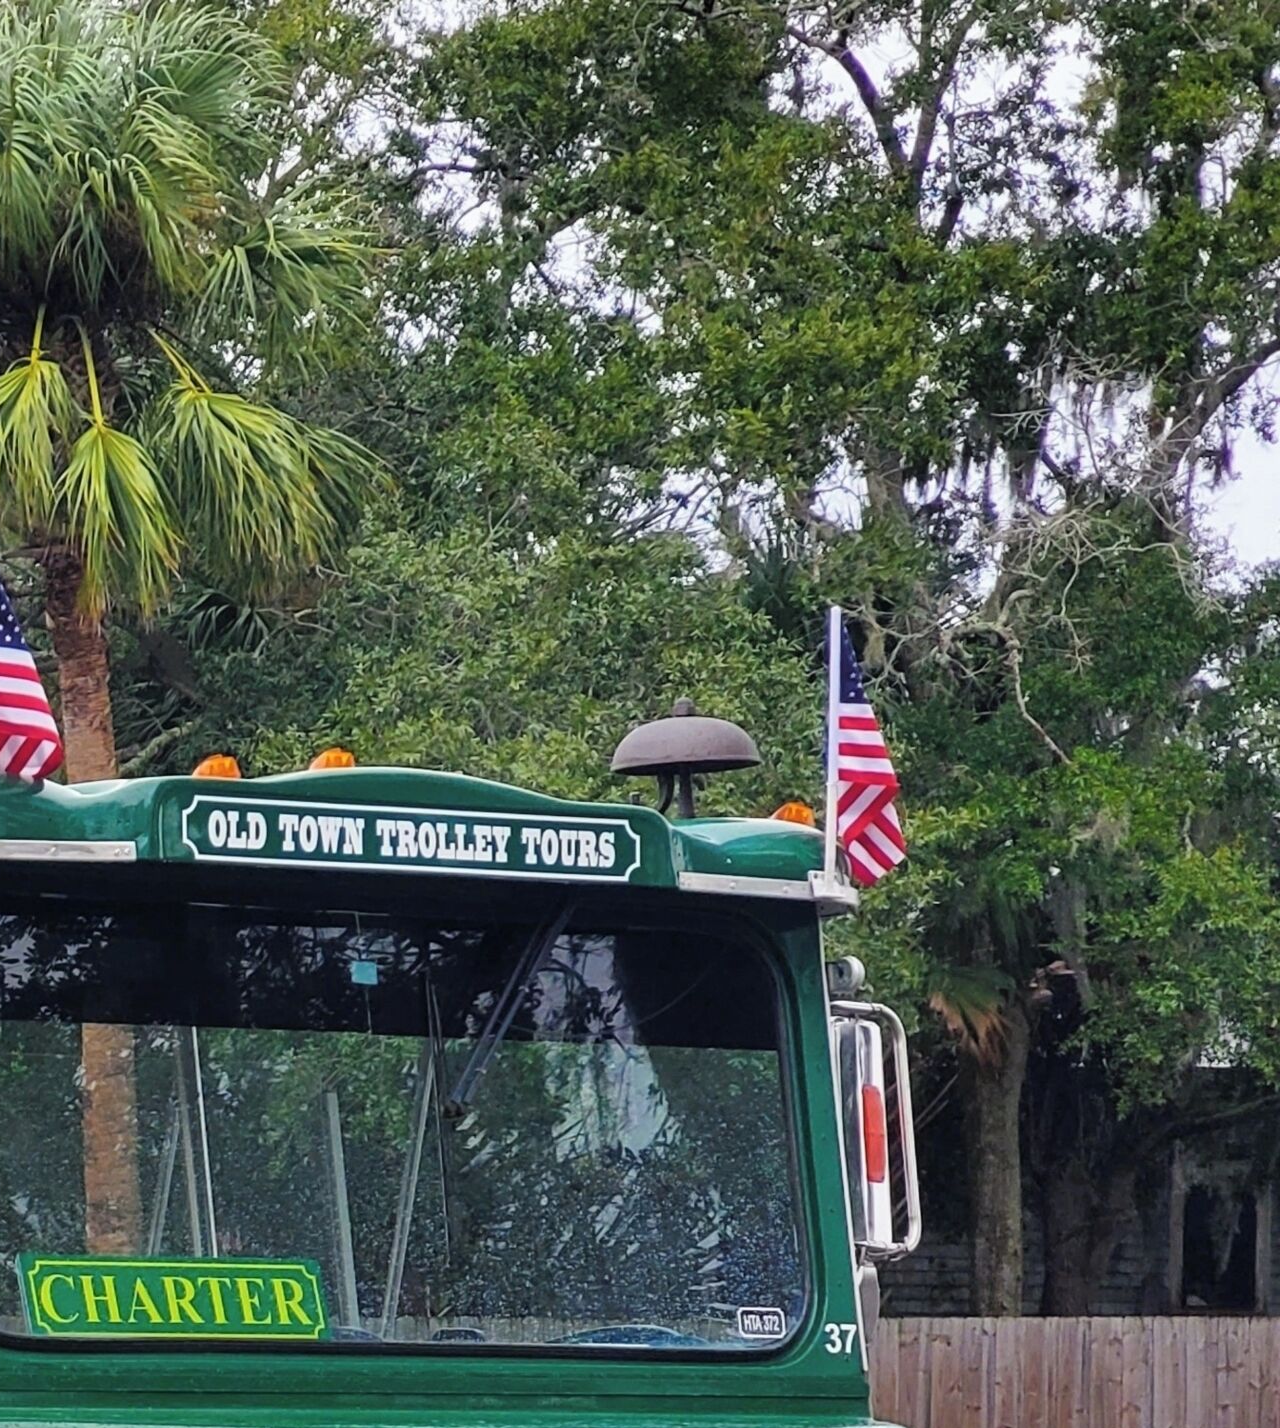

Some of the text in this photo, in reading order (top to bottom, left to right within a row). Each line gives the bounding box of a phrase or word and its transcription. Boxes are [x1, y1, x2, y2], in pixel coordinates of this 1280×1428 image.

[207, 809, 615, 868] OLD TOWN TROLLEY TOURS
[40, 1274, 314, 1325] CHARTER
[824, 1323, 857, 1354] 37
